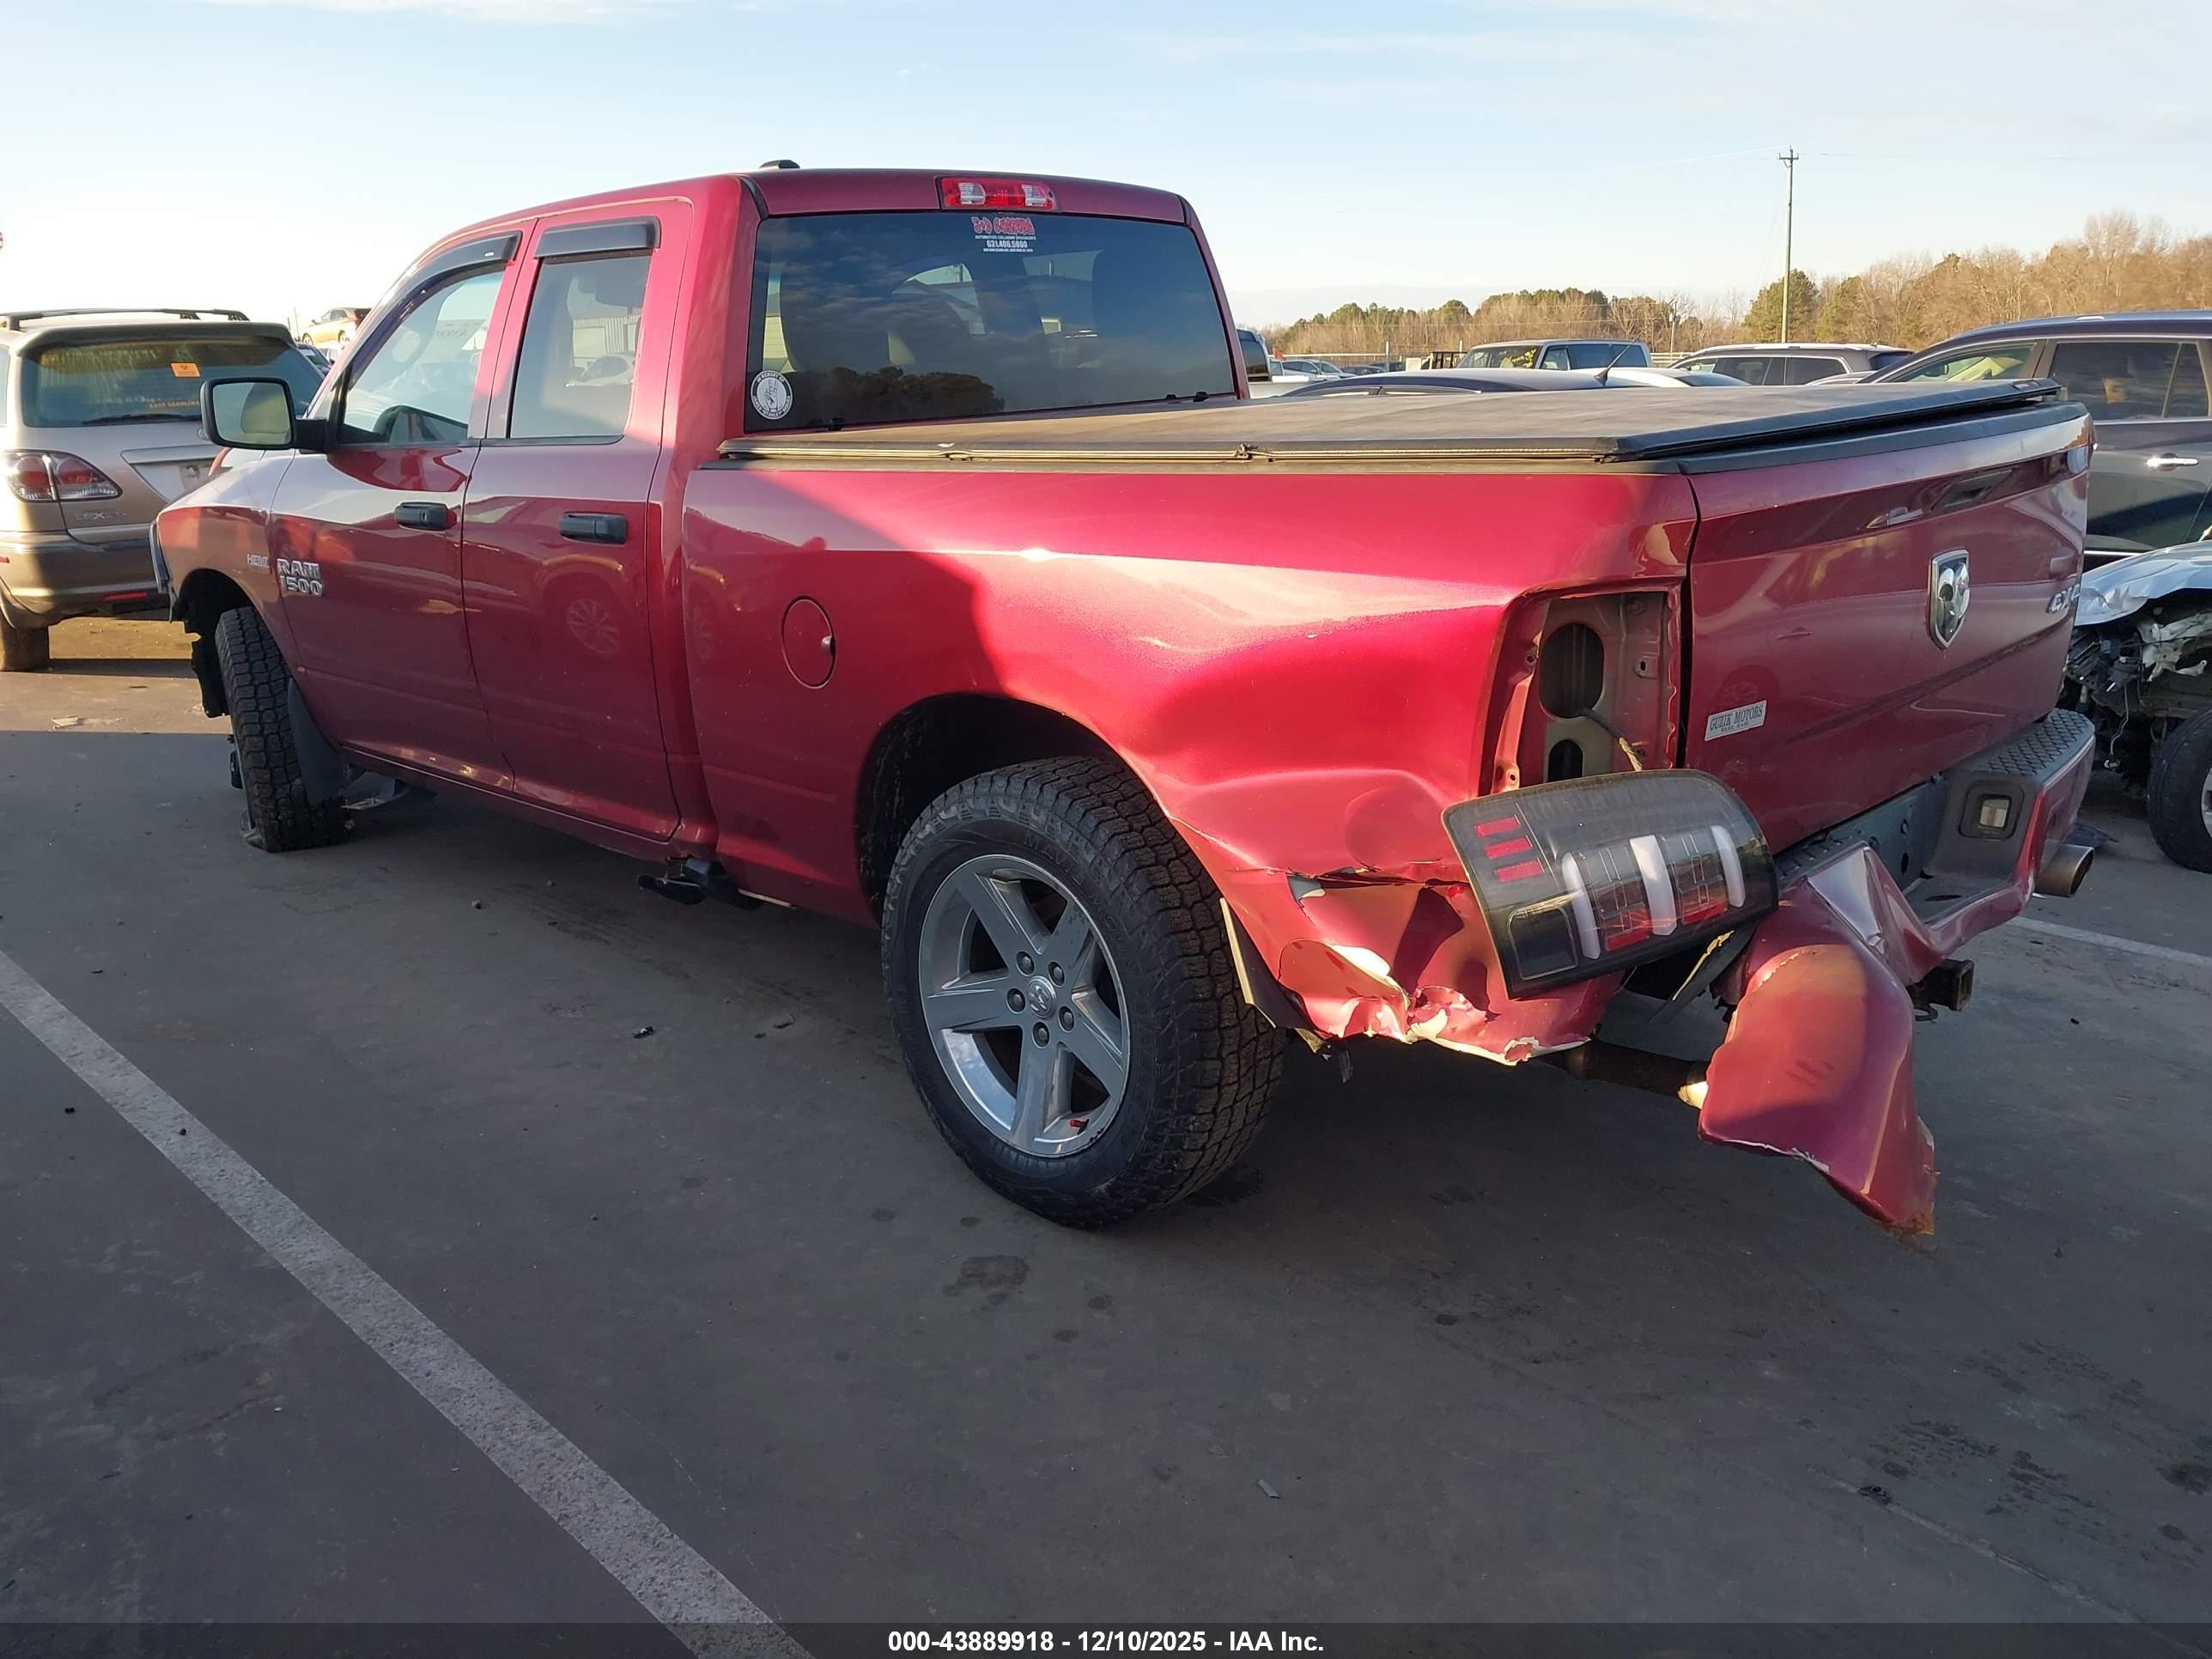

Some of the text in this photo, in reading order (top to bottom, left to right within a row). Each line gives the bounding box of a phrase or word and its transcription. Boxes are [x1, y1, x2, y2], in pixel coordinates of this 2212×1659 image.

[276, 557, 320, 579] RAM
[279, 575, 323, 598] 1500
[1734, 704, 1764, 724] MOTORS
